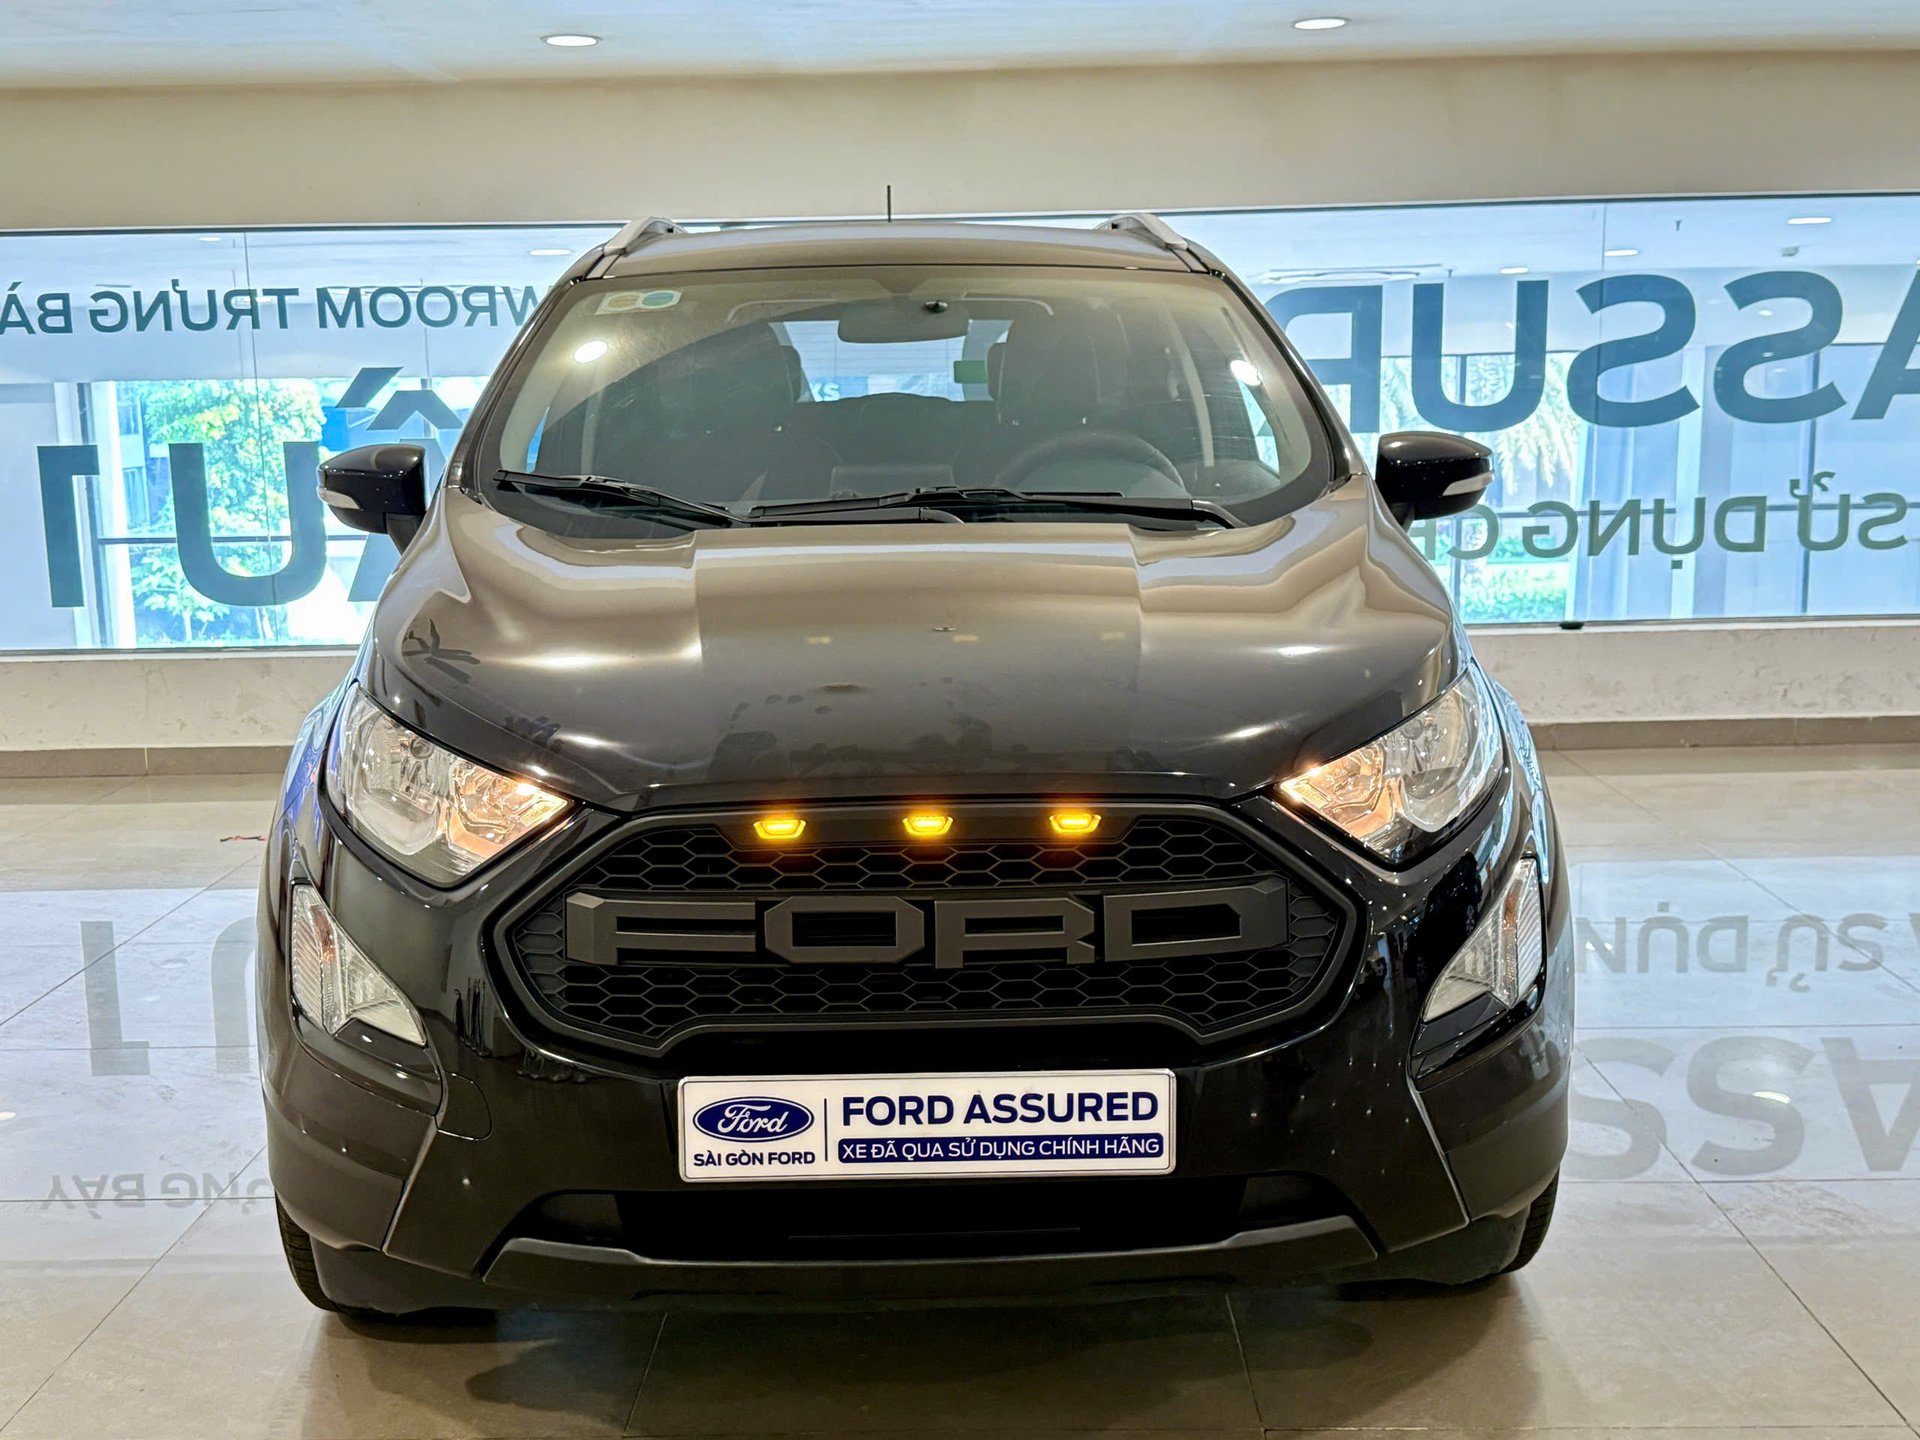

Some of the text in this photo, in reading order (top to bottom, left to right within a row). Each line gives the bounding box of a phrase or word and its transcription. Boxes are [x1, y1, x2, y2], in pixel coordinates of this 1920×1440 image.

[565, 875, 1288, 969] FORD
[717, 1104, 789, 1133] Ford
[843, 1092, 1158, 1126] FORD ASSURED
[694, 1150, 815, 1166] SÀI GÒN FORD
[842, 1136, 1159, 1161] XE ĐÃ QUA SỬ DỤNG CHÍNH HÃNG
